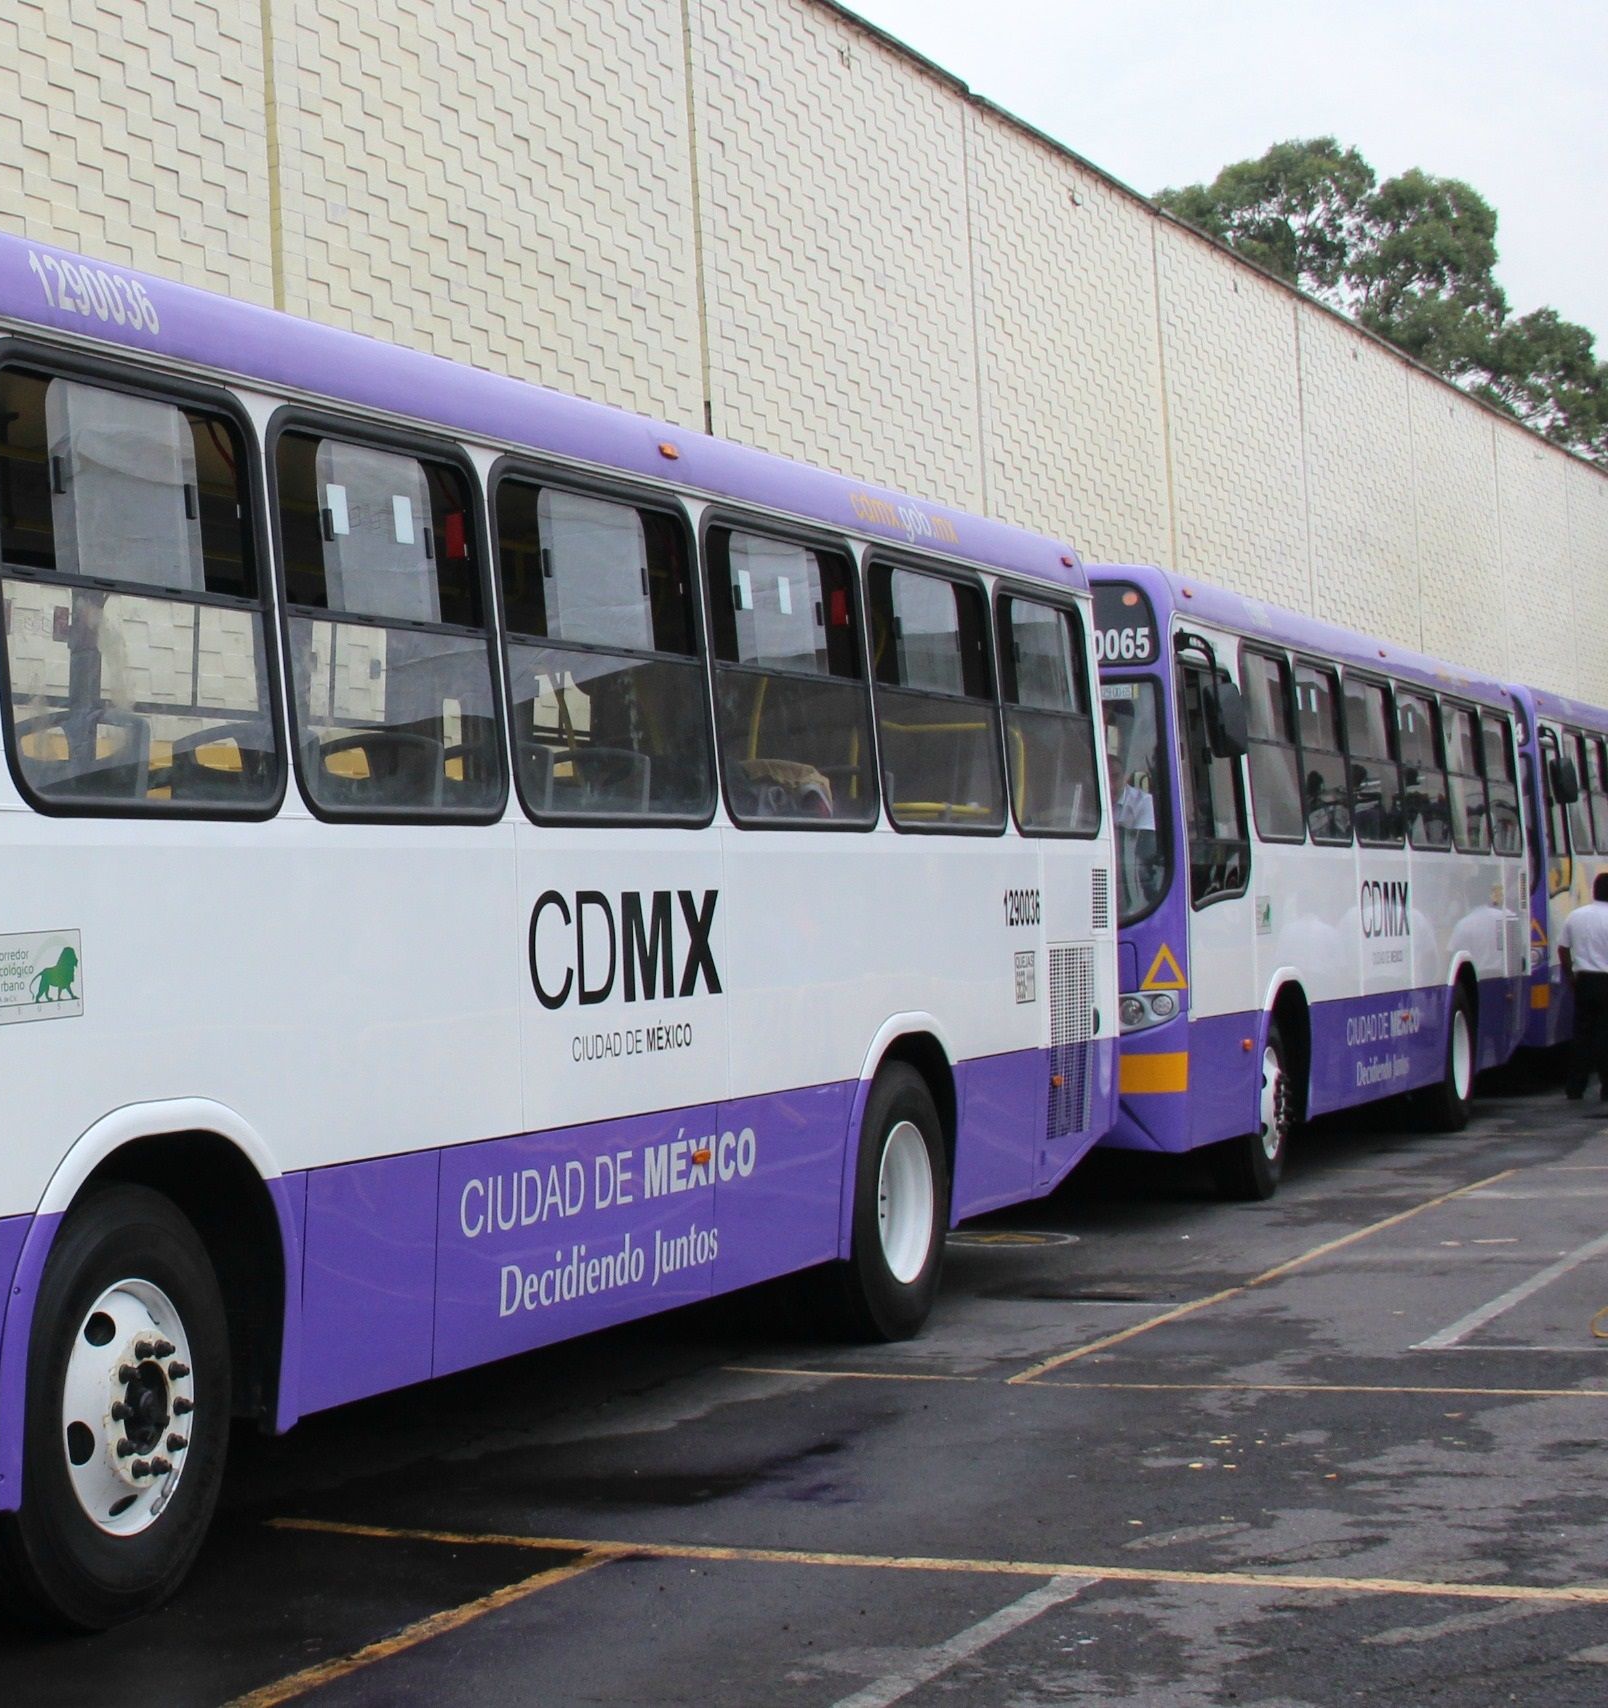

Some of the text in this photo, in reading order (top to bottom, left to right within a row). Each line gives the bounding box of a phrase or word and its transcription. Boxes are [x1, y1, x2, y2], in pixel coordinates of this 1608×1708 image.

[28, 249, 160, 335] 1290036
[528, 889, 723, 1010] CDMX
[1003, 888, 1041, 927] 1290036
[1360, 879, 1410, 939] CDMX
[572, 1019, 692, 1062] CIUDAD DE MÉXICO
[460, 1127, 757, 1239] CIUDAD DE MÉXICO
[499, 1224, 719, 1318] Decidiendo Juntos
